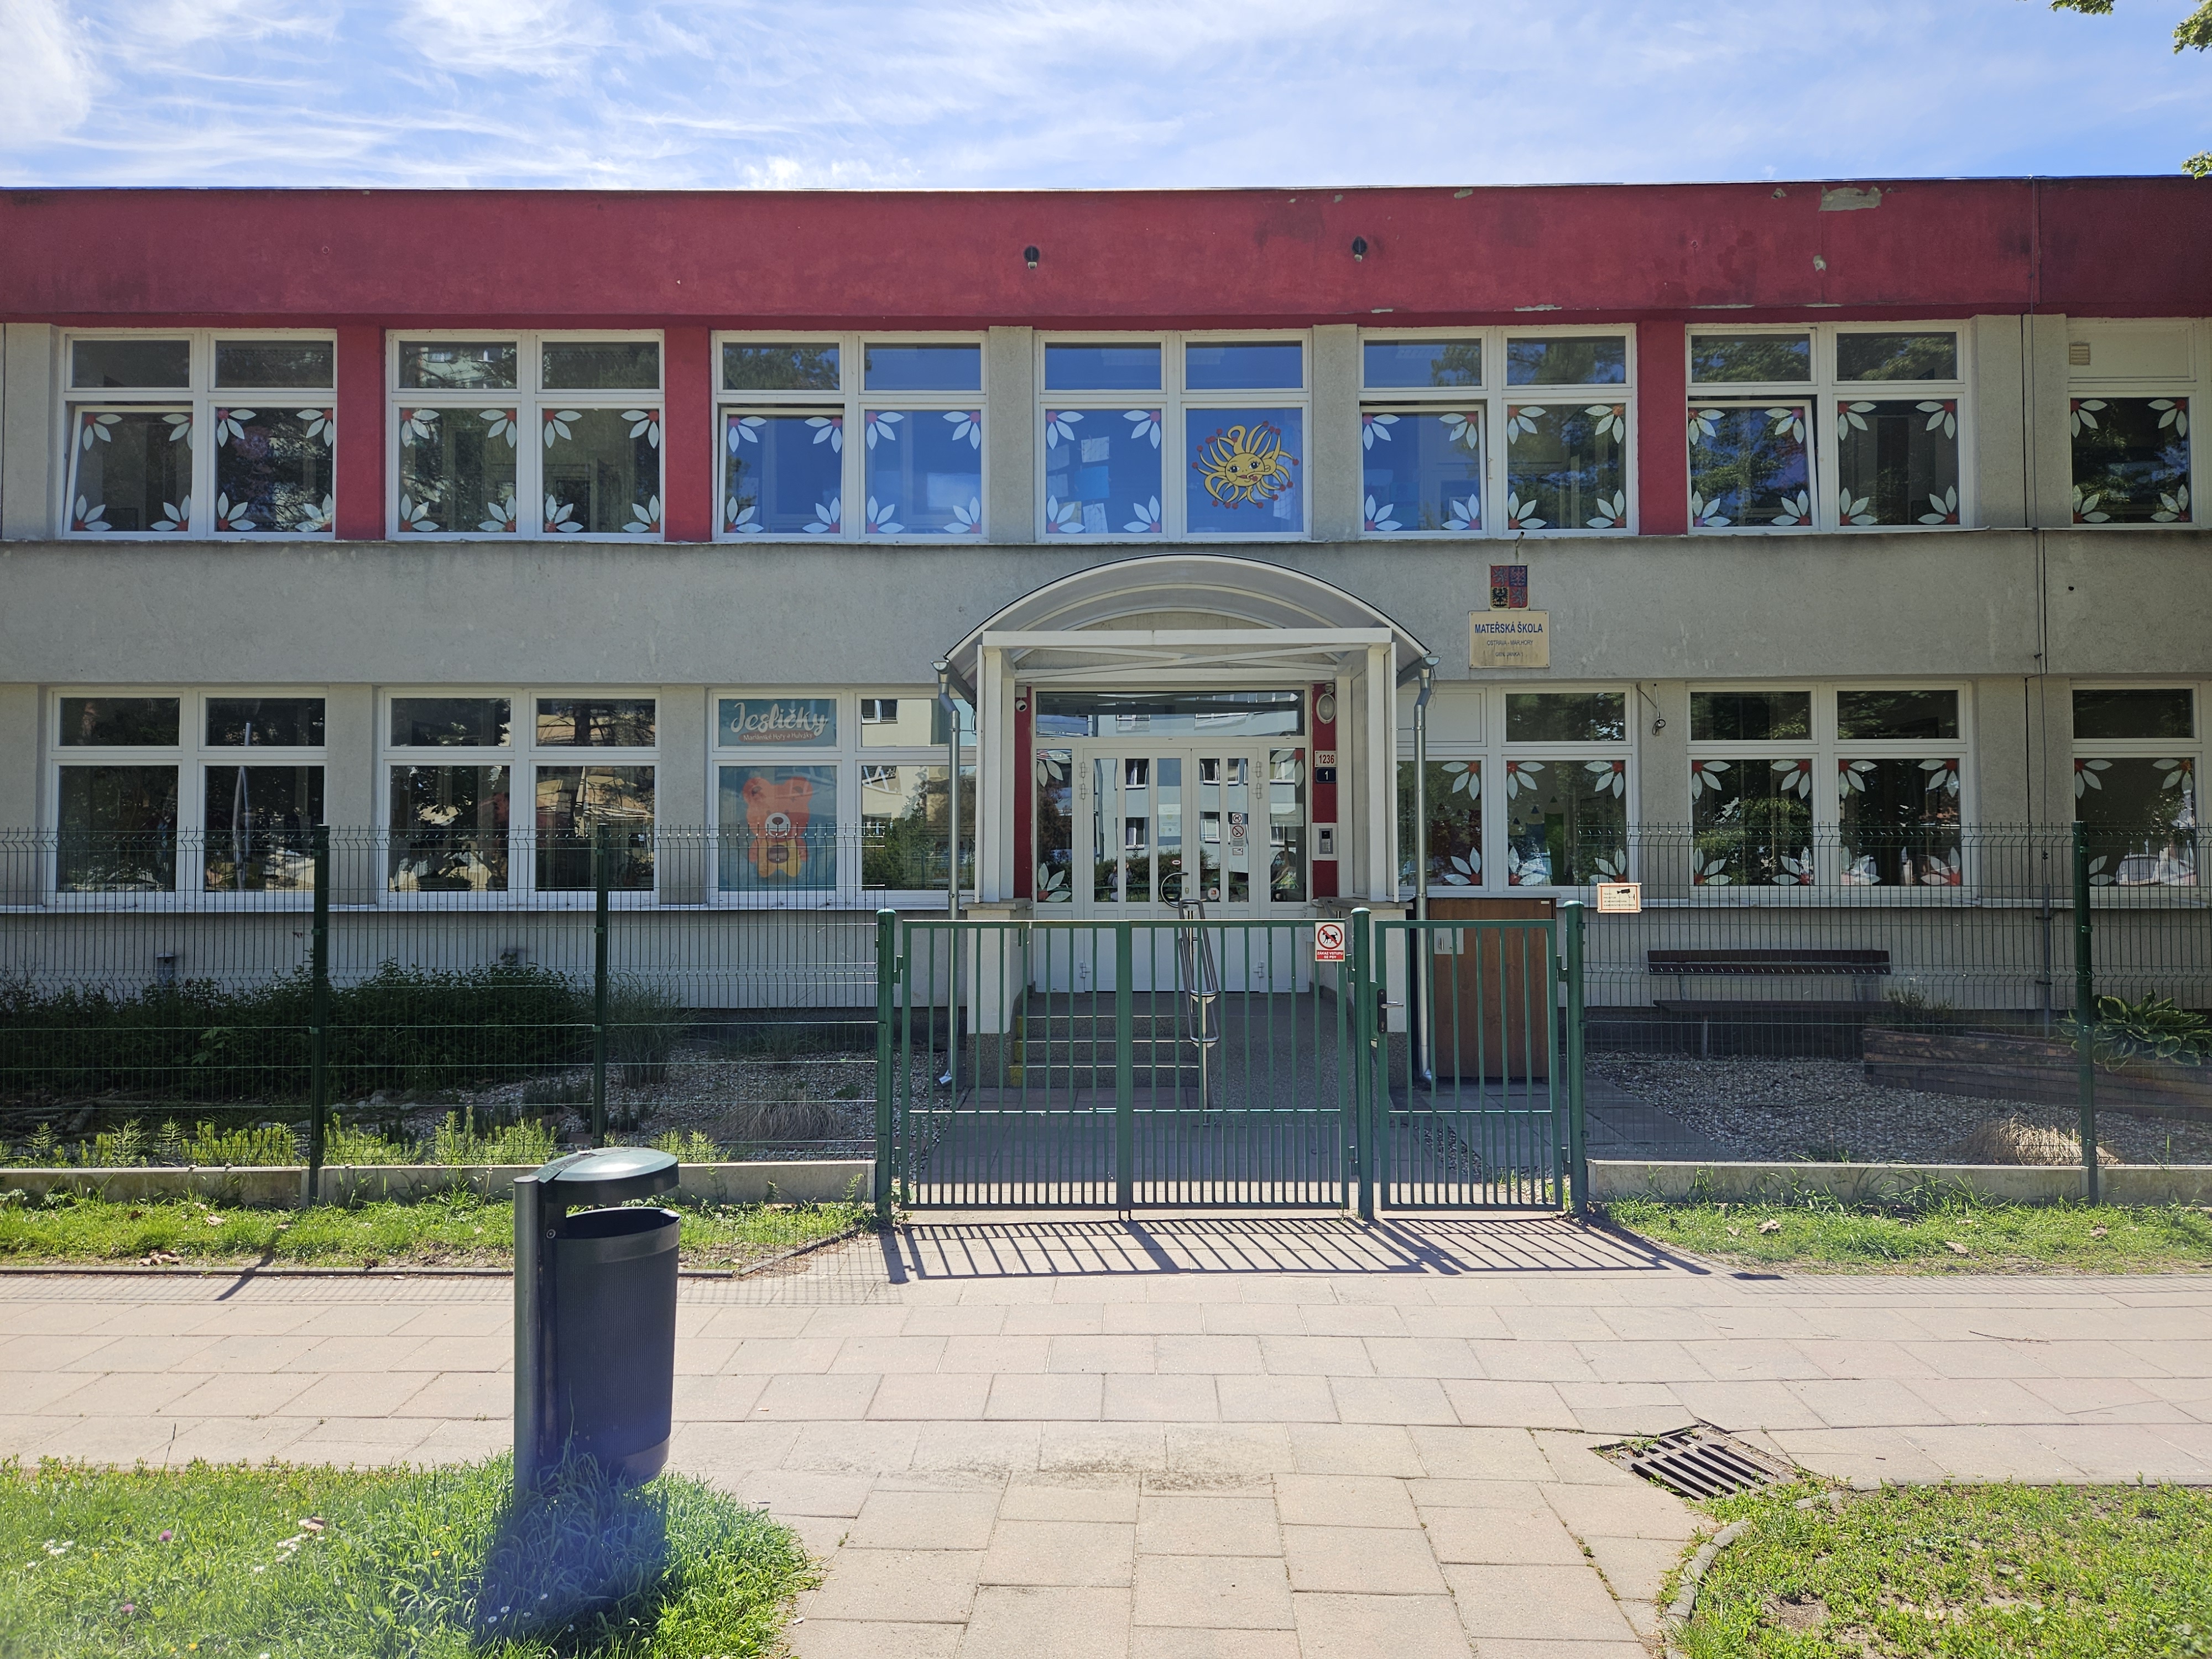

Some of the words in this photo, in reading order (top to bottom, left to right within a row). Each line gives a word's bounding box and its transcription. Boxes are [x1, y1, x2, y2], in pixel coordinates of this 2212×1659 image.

[1475, 621, 1516, 634] MATEŘSKÁ
[1517, 621, 1543, 633] ŠKOLA
[731, 702, 828, 737] Jesličky
[1319, 754, 1334, 764] 1236
[1324, 770, 1328, 780] 1
